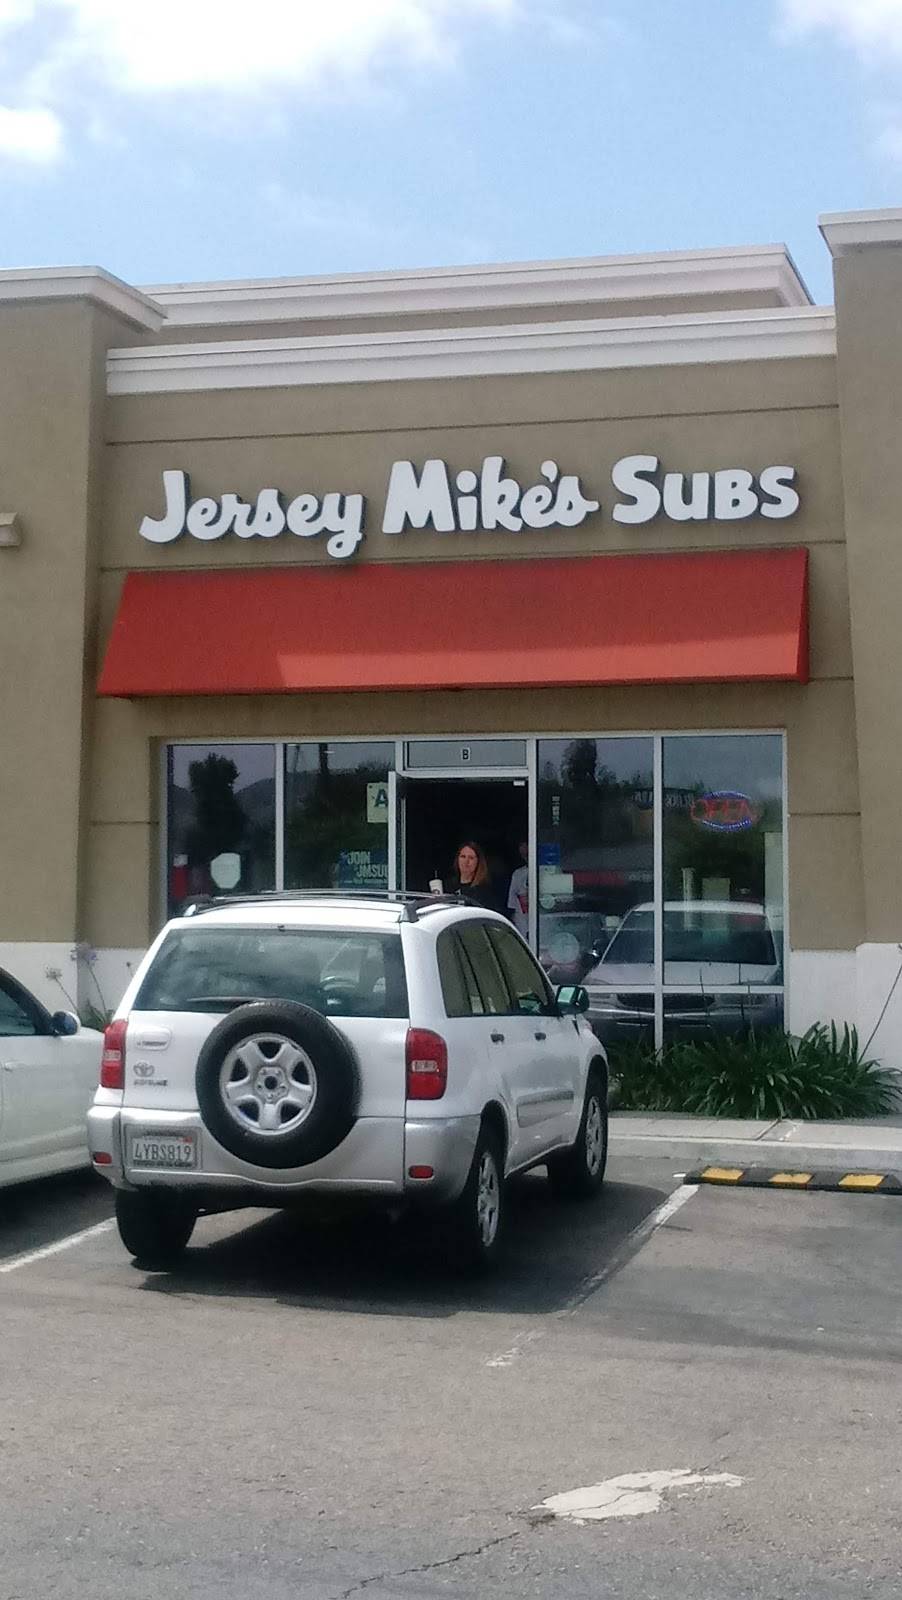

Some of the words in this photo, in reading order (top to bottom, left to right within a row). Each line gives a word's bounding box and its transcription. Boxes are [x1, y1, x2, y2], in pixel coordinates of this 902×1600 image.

[139, 470, 364, 558] Jersey
[382, 456, 600, 534] Mike's
[611, 454, 800, 525] SUBS
[462, 749, 469, 760] B
[374, 788, 388, 807] A
[347, 851, 371, 865] JOIN
[135, 1144, 192, 1162] 4YBS819
